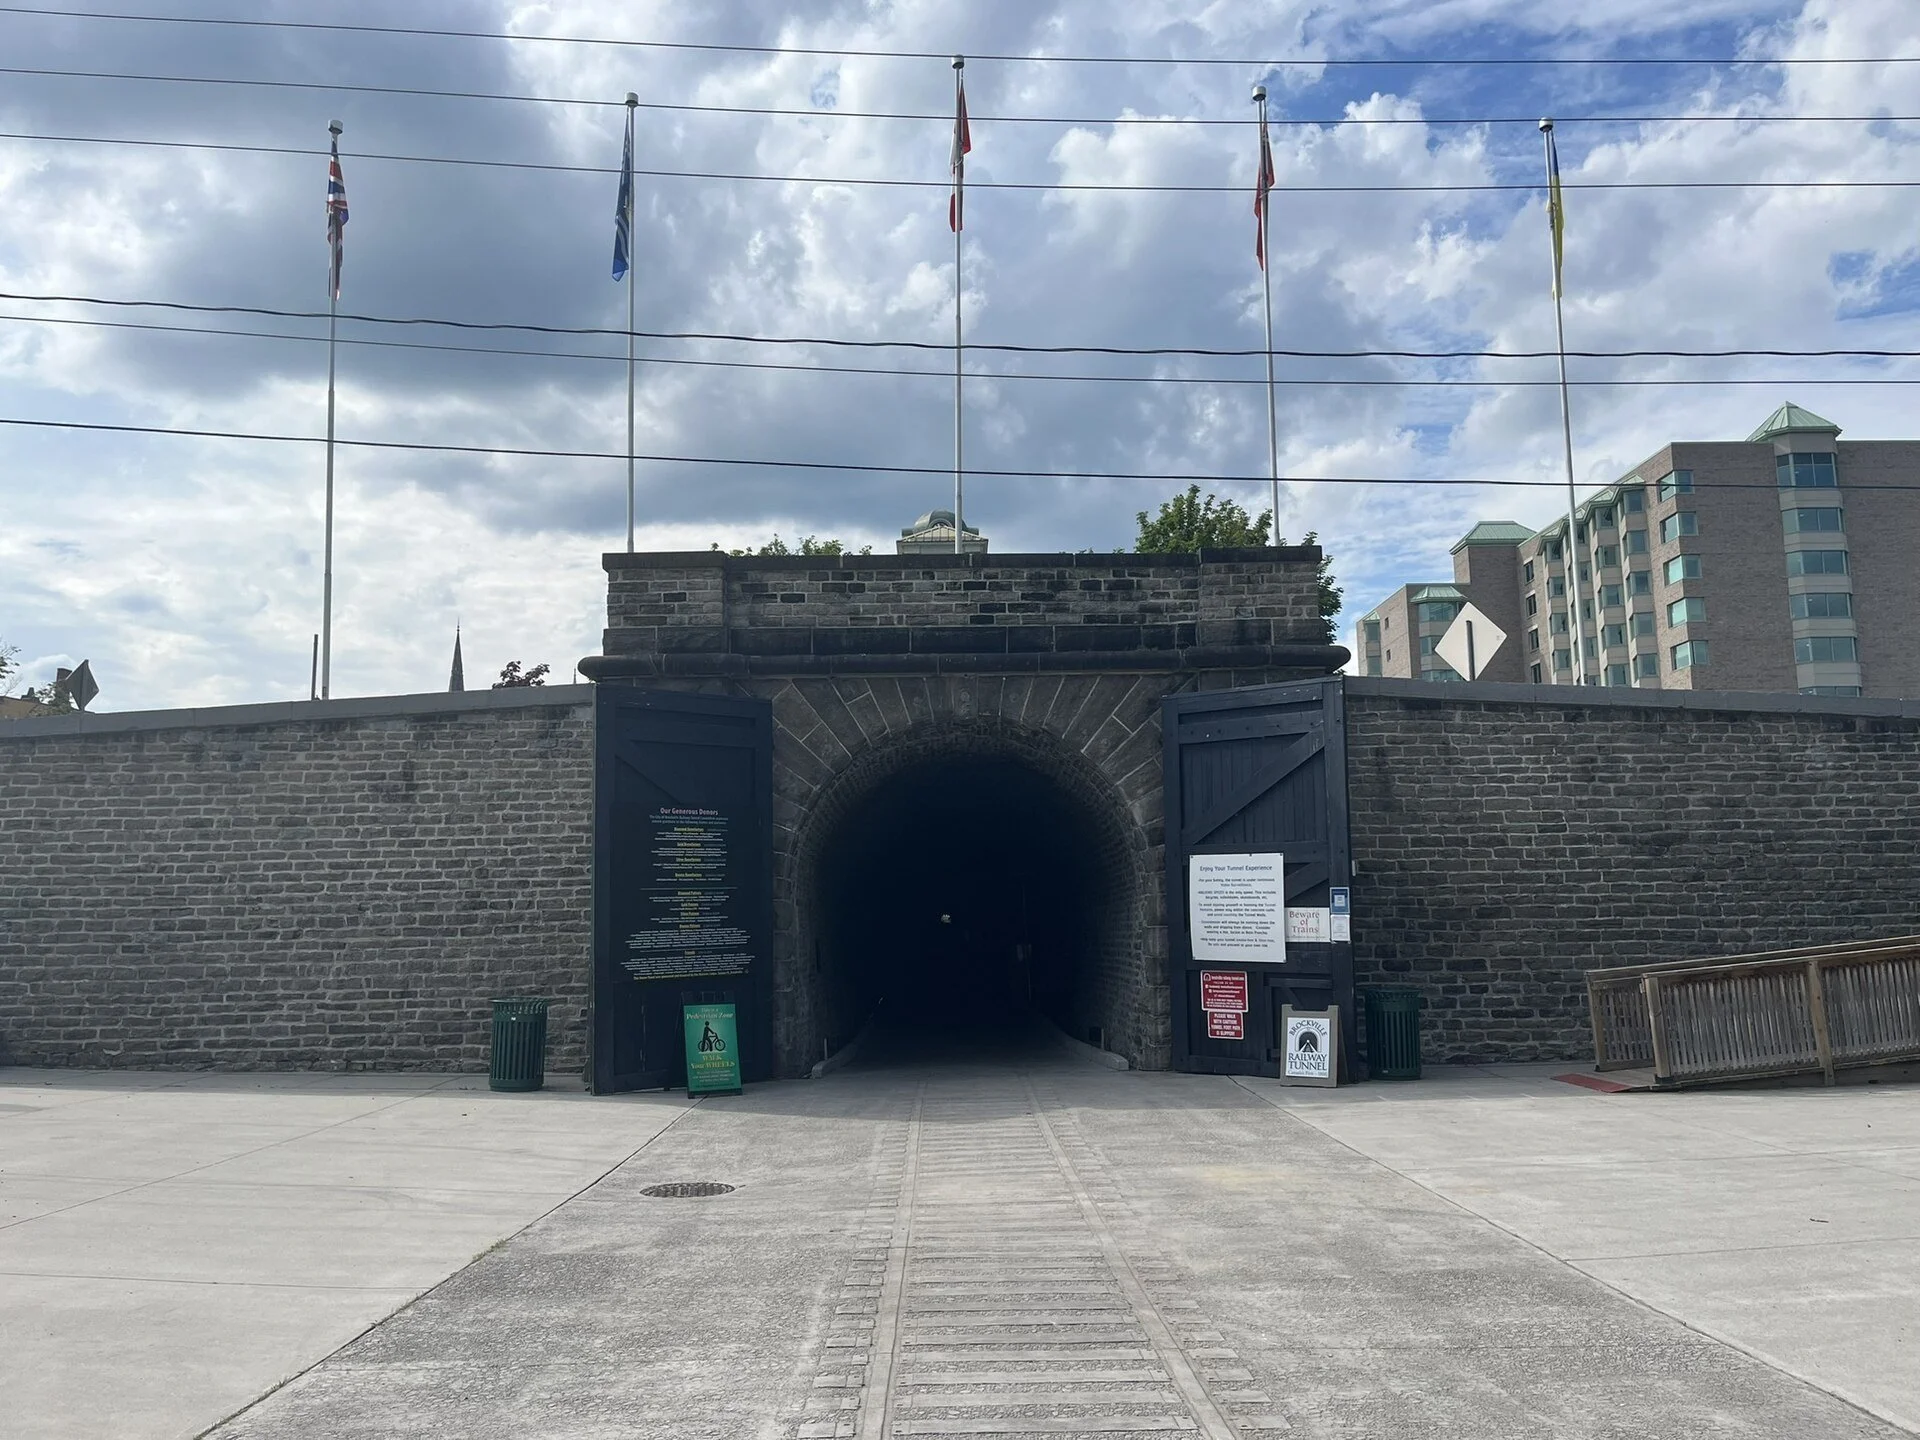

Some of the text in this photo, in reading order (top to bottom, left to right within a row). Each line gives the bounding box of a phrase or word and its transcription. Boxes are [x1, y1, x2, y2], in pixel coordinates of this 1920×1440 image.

[1289, 911, 1320, 919] Beware
[1289, 1020, 1327, 1036] BROCKVILLE
[1288, 1053, 1327, 1061] RAILWAY
[1288, 1061, 1327, 1070] TUNNEL
